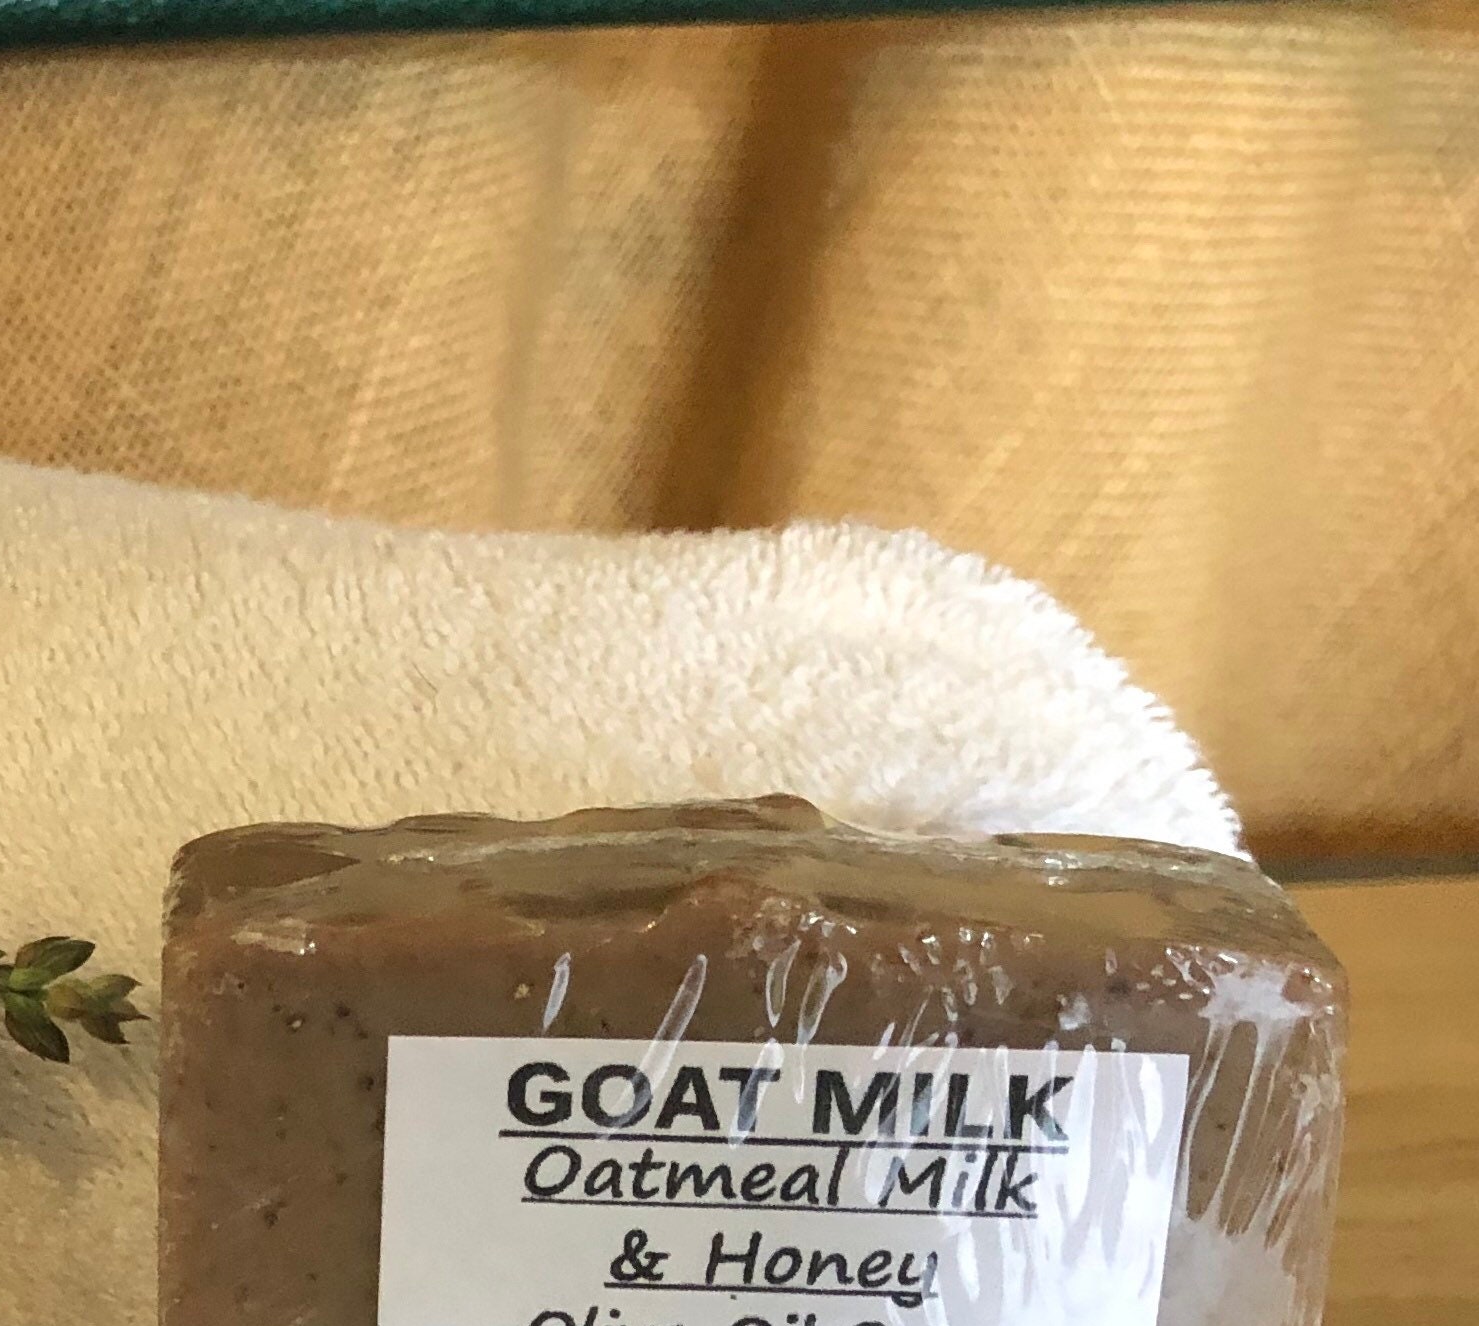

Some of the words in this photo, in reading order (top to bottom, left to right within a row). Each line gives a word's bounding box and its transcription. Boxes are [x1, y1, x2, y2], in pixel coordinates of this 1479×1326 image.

[506, 1062, 783, 1134] GOAT
[810, 1070, 1075, 1148] MILK
[523, 1145, 846, 1207] Oatmeal
[886, 1150, 1039, 1214] Milk
[609, 1230, 669, 1285] &
[705, 1231, 939, 1307] Honey
